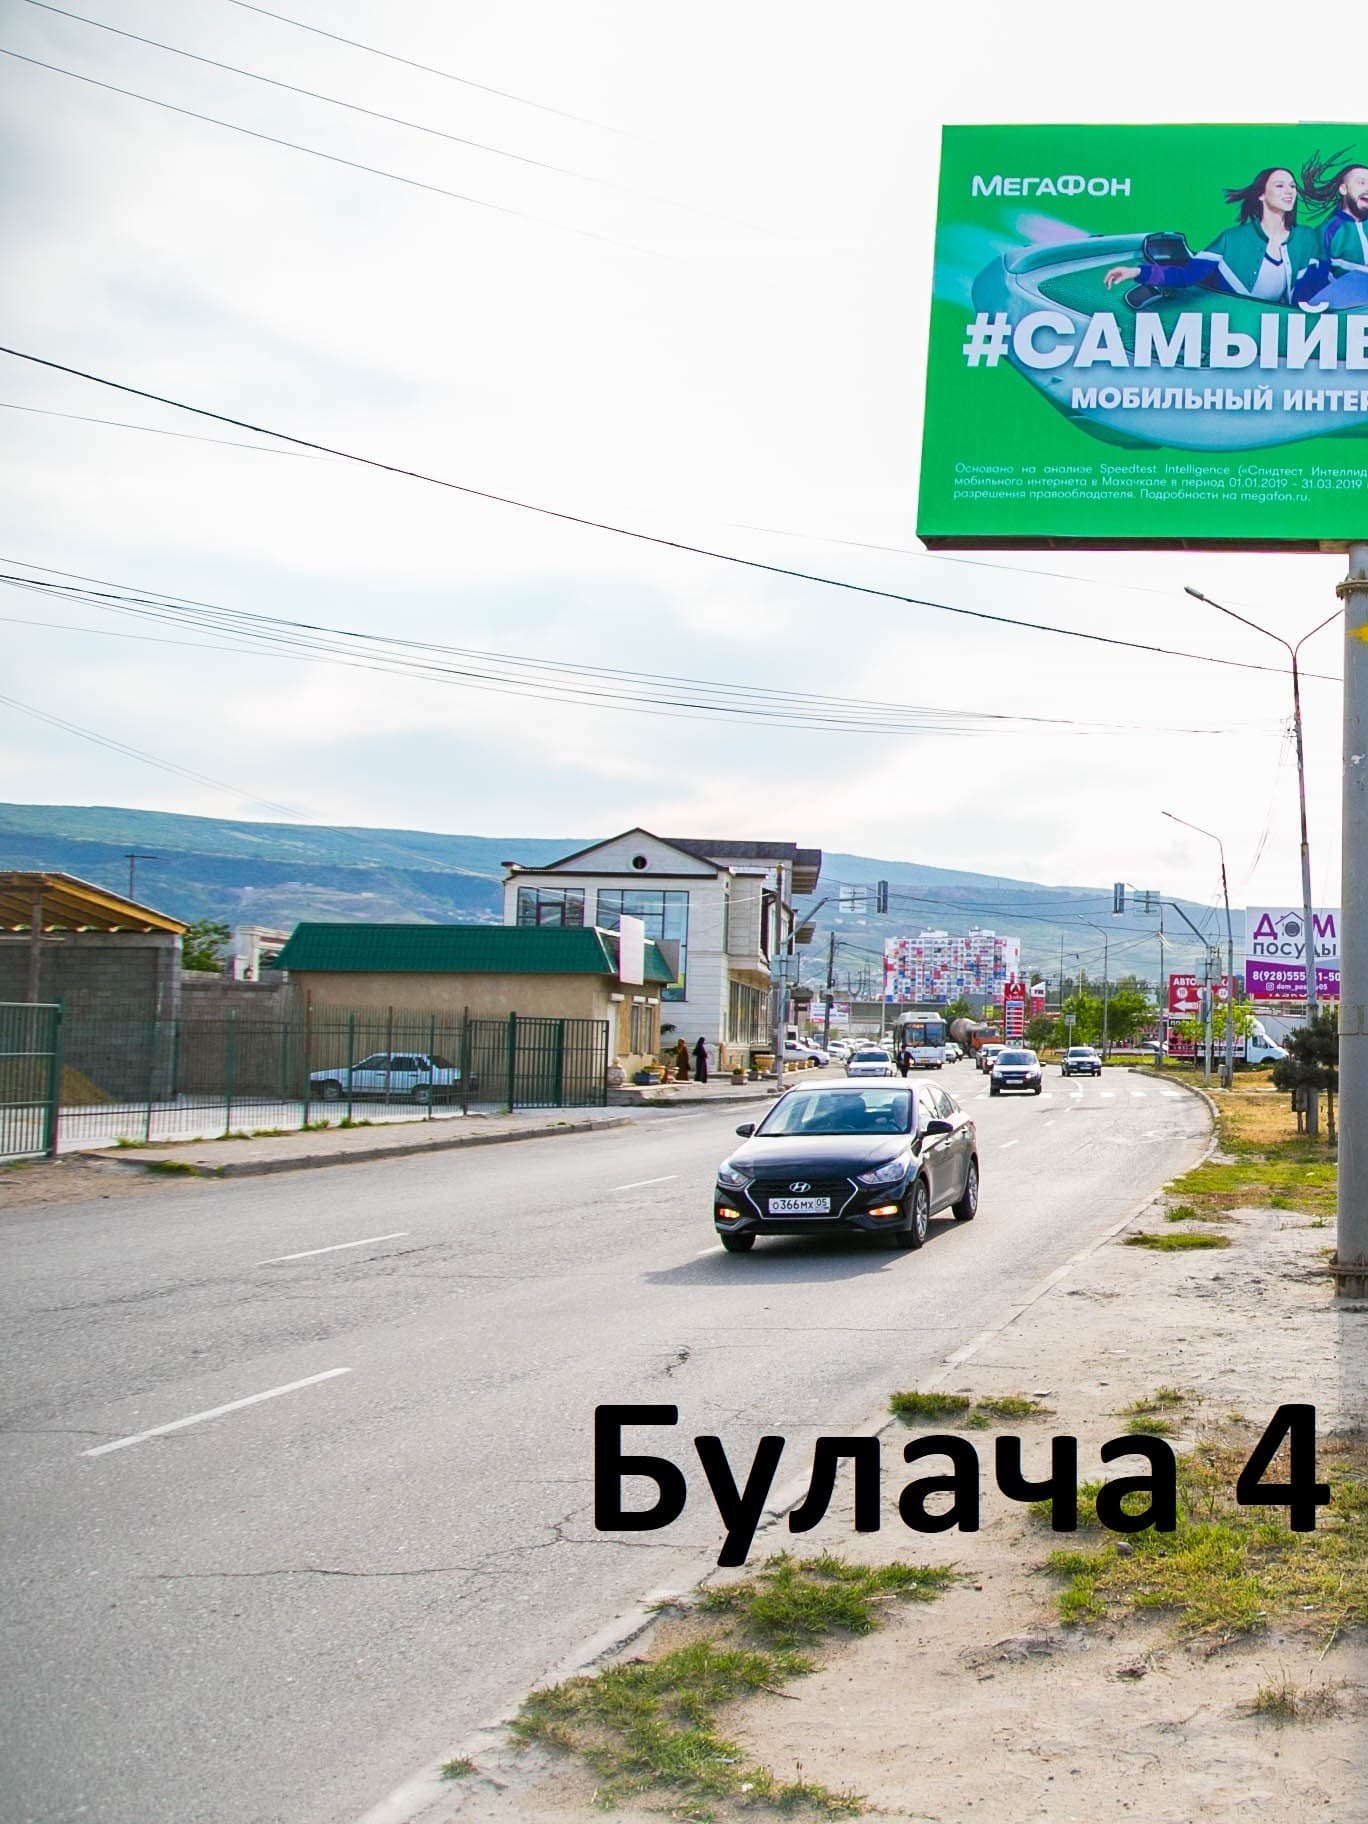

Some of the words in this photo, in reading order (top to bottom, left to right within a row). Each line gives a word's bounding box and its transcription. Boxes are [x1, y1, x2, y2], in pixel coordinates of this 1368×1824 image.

[1071, 385, 1273, 411] МОБИЛЬНЫЙ
[955, 463, 1013, 473] Основано
[1044, 466, 1093, 474] анализе
[1100, 463, 1157, 477] Speedtest
[1165, 464, 1230, 477] Intelligence
[954, 475, 1023, 486] мобильного
[1027, 478, 1087, 489] интернета
[1102, 476, 1167, 487] Махачкале
[1181, 479, 1224, 489] период
[1229, 476, 1288, 487] 01.01.2019
[1302, 477, 1362, 489] 31.03.2019
[953, 490, 1025, 500] разрешения
[1029, 487, 1133, 501] правообладателя.
[1140, 488, 1219, 502] Подробности
[1240, 489, 1310, 503] megafon.ru.
